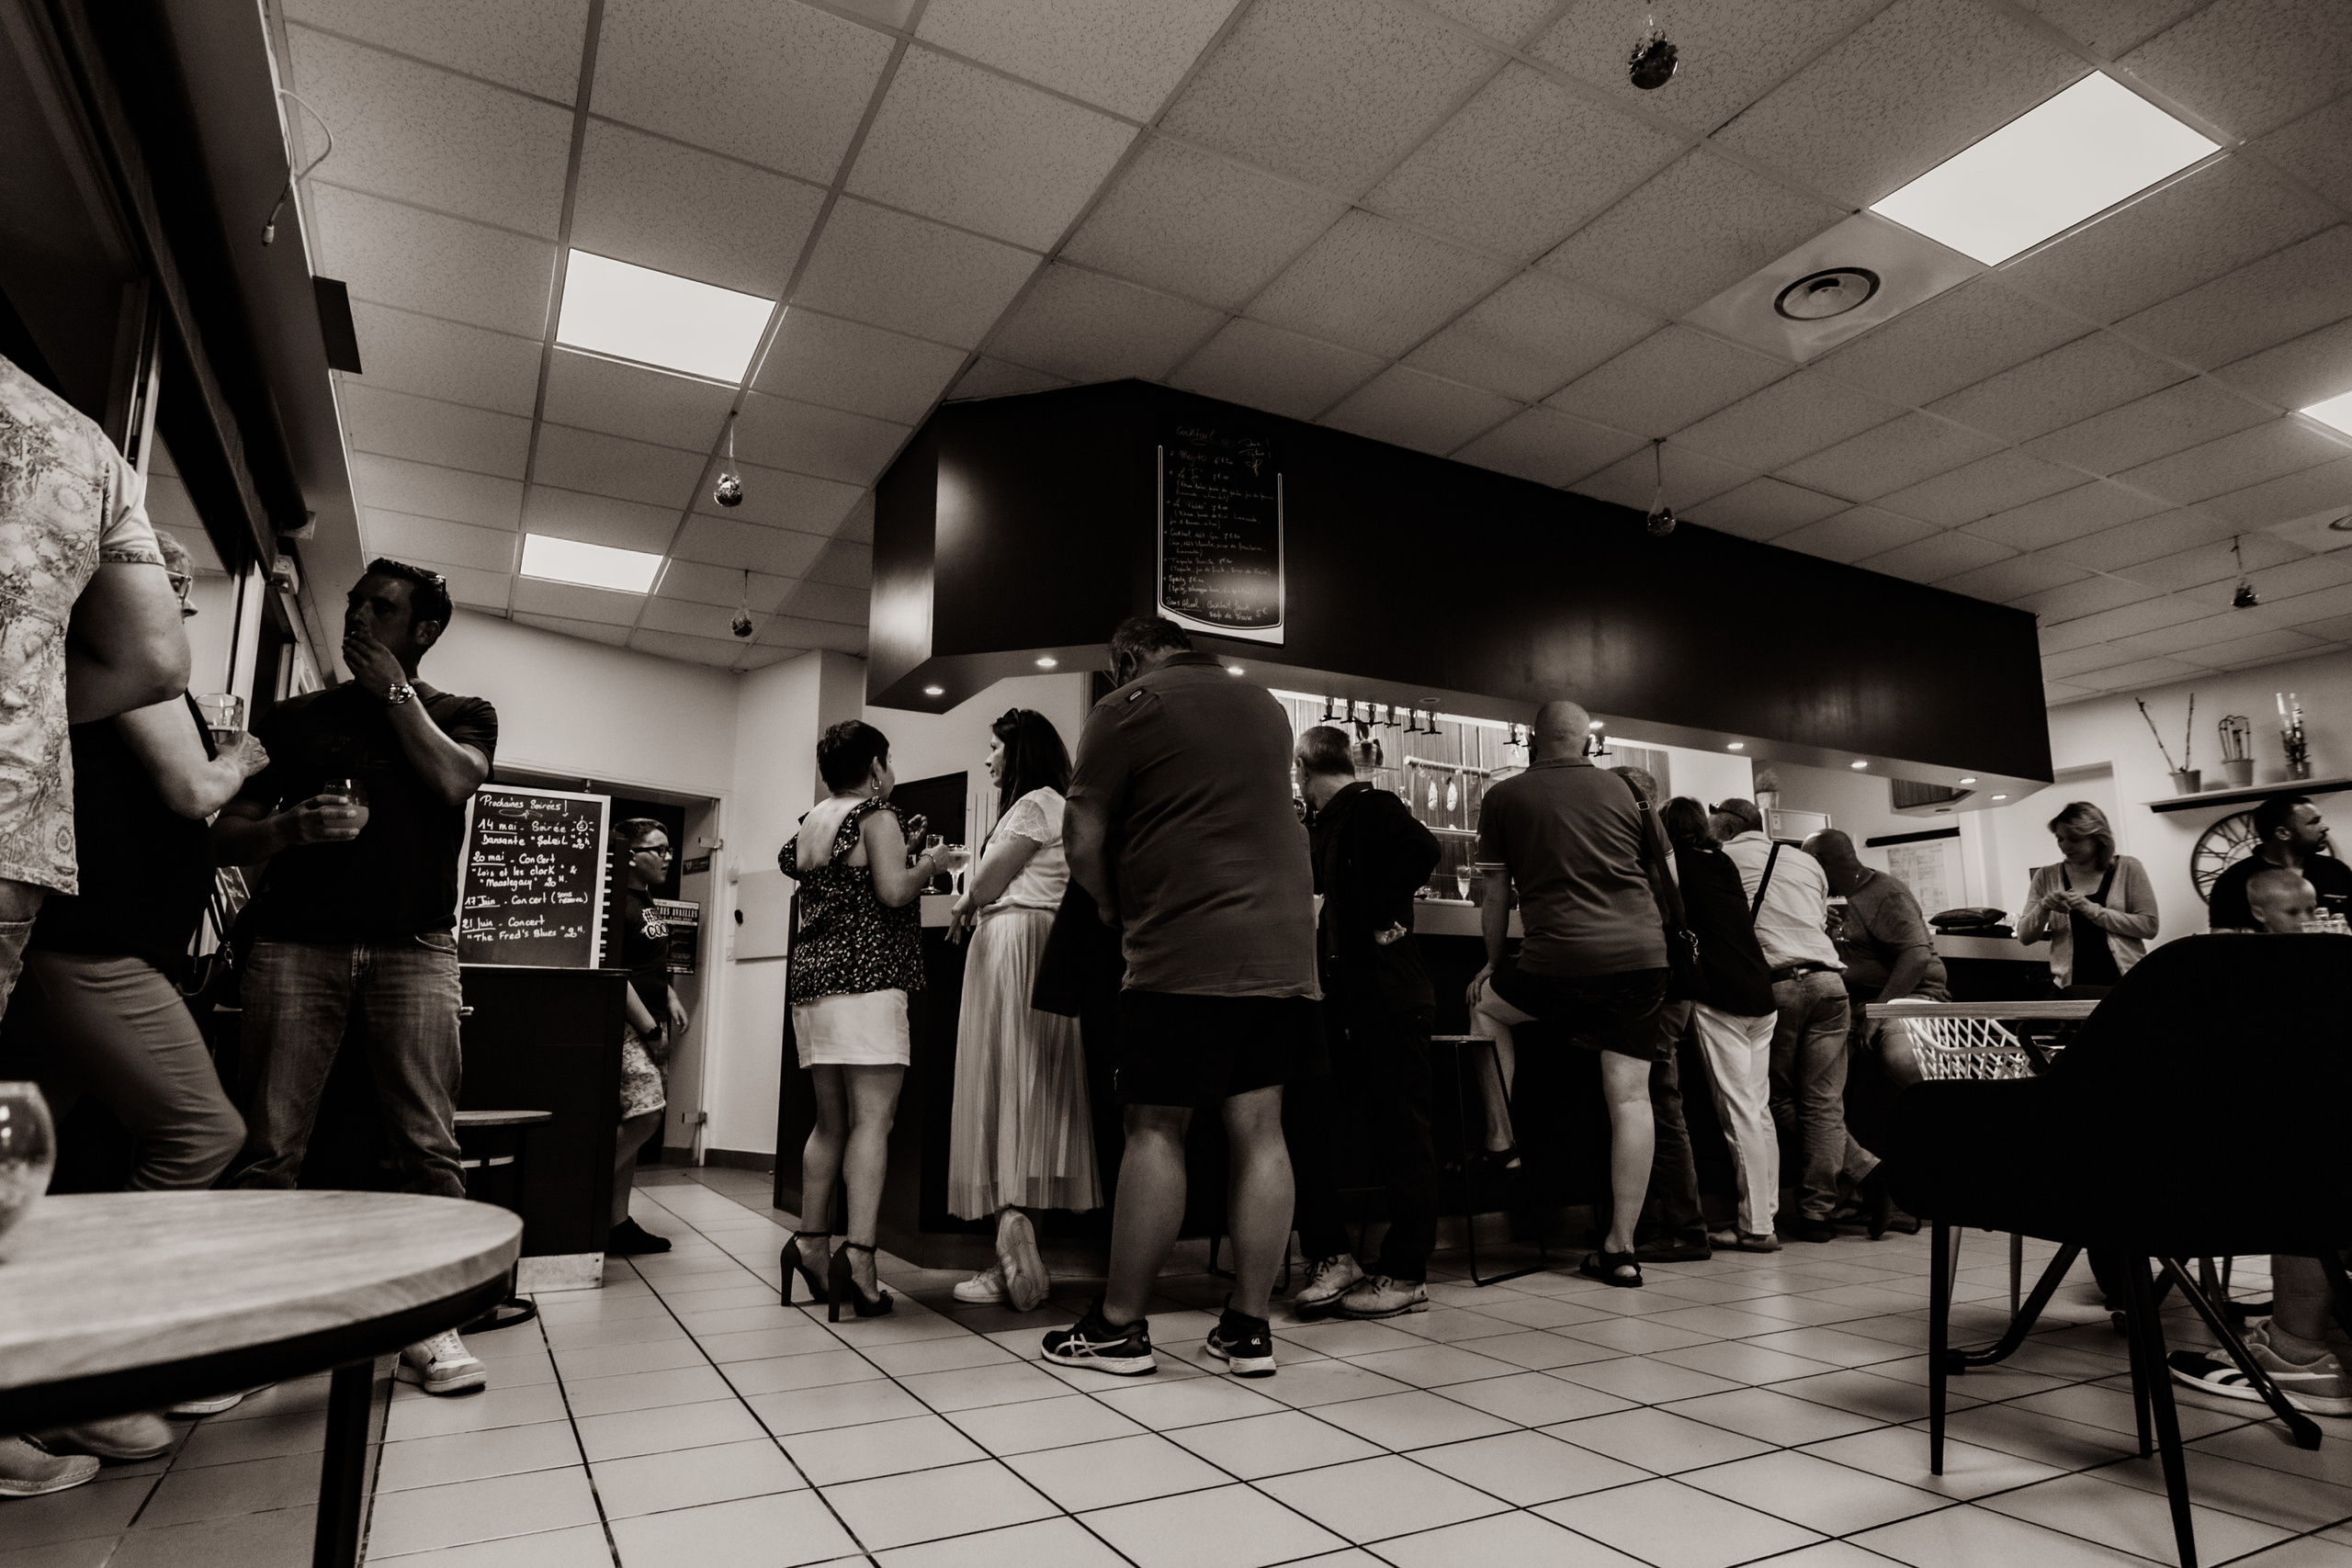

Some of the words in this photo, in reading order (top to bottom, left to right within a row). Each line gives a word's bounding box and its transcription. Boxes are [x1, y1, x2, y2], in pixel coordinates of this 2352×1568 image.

[1179, 450, 1207, 467] Mojito
[480, 795, 524, 808] Prochaines
[530, 799, 561, 811] Soirées
[478, 818, 493, 830] 14
[499, 821, 517, 830] mai
[532, 820, 567, 833] Soirée
[481, 834, 526, 846] Dansante
[472, 851, 485, 862] 20
[488, 852, 504, 861] mai
[499, 868, 508, 876] et
[514, 866, 525, 875] les
[570, 865, 578, 874] &
[464, 896, 476, 906] 17
[477, 895, 496, 907] Juin
[511, 892, 547, 905] Concert
[673, 908, 698, 918] AVAILLES
[461, 919, 473, 930] 21
[477, 917, 493, 930] Juin
[508, 914, 545, 927] Concert
[499, 929, 529, 940] Fred's
